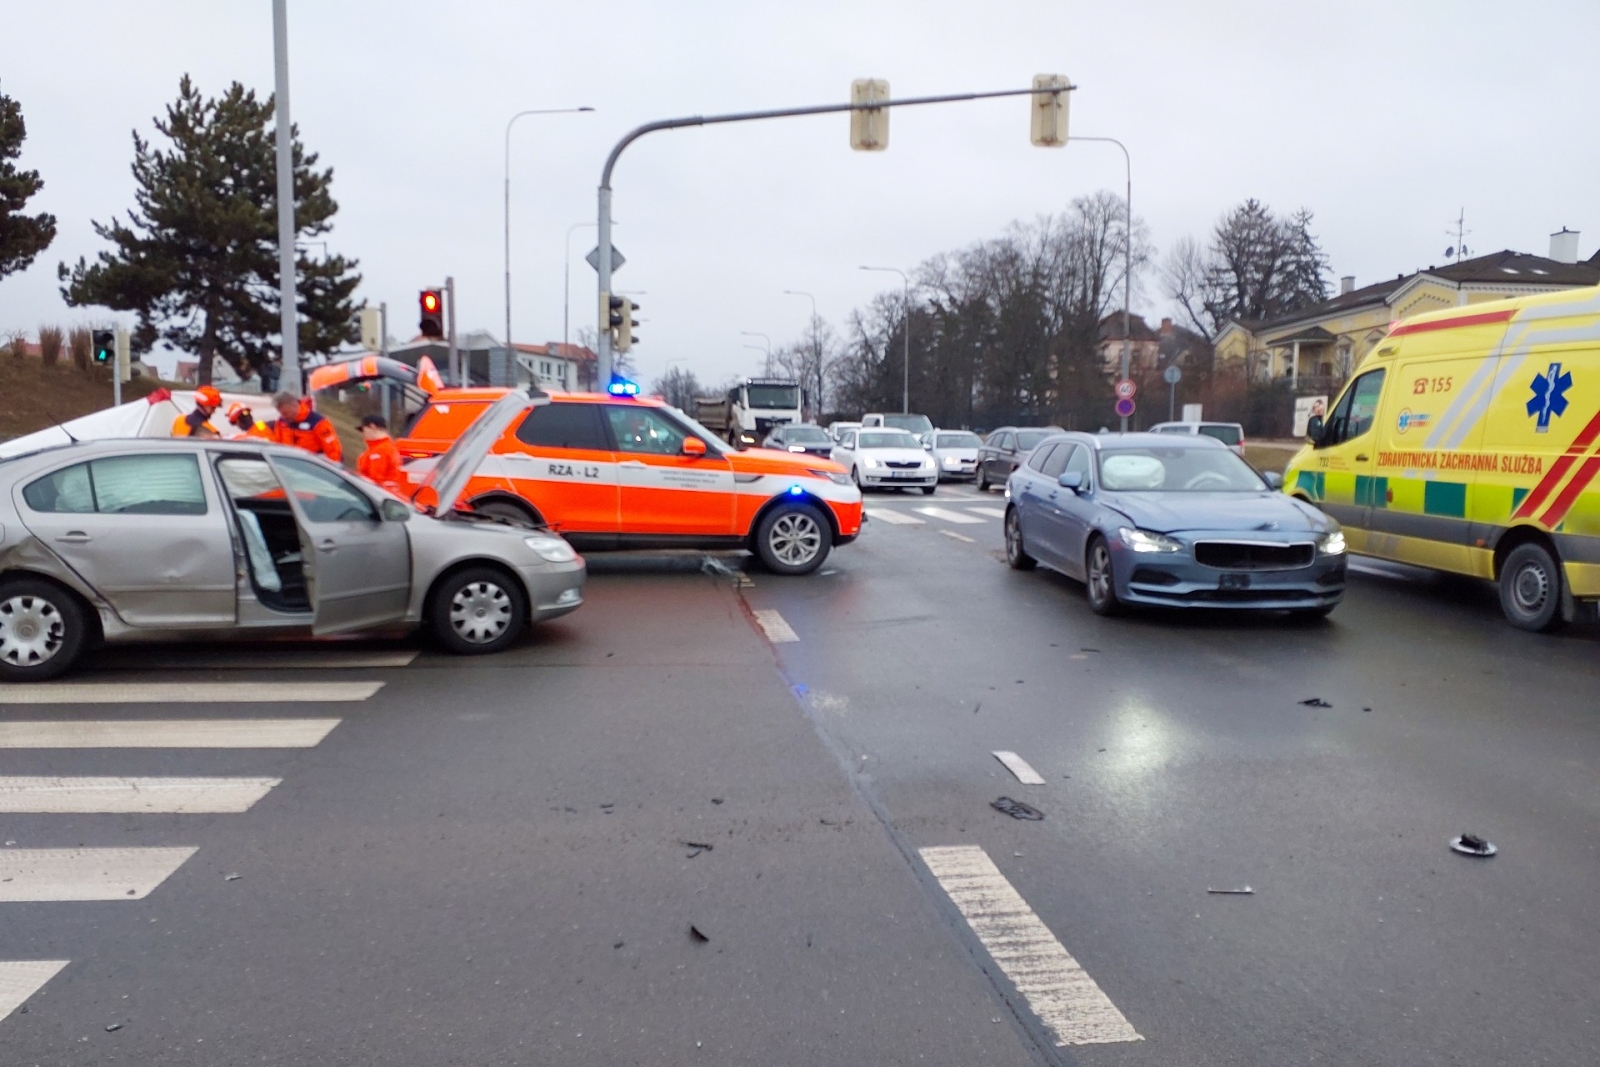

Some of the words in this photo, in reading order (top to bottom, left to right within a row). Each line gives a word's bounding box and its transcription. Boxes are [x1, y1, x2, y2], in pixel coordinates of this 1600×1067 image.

[1431, 376, 1453, 393] 155
[548, 464, 574, 476] RZA
[584, 466, 600, 478] L2
[1377, 451, 1437, 469] ZDRAVOTNICKÁ
[1440, 451, 1498, 472] ZÁCHRANNÁ
[1501, 453, 1542, 475] SLUŽBA
